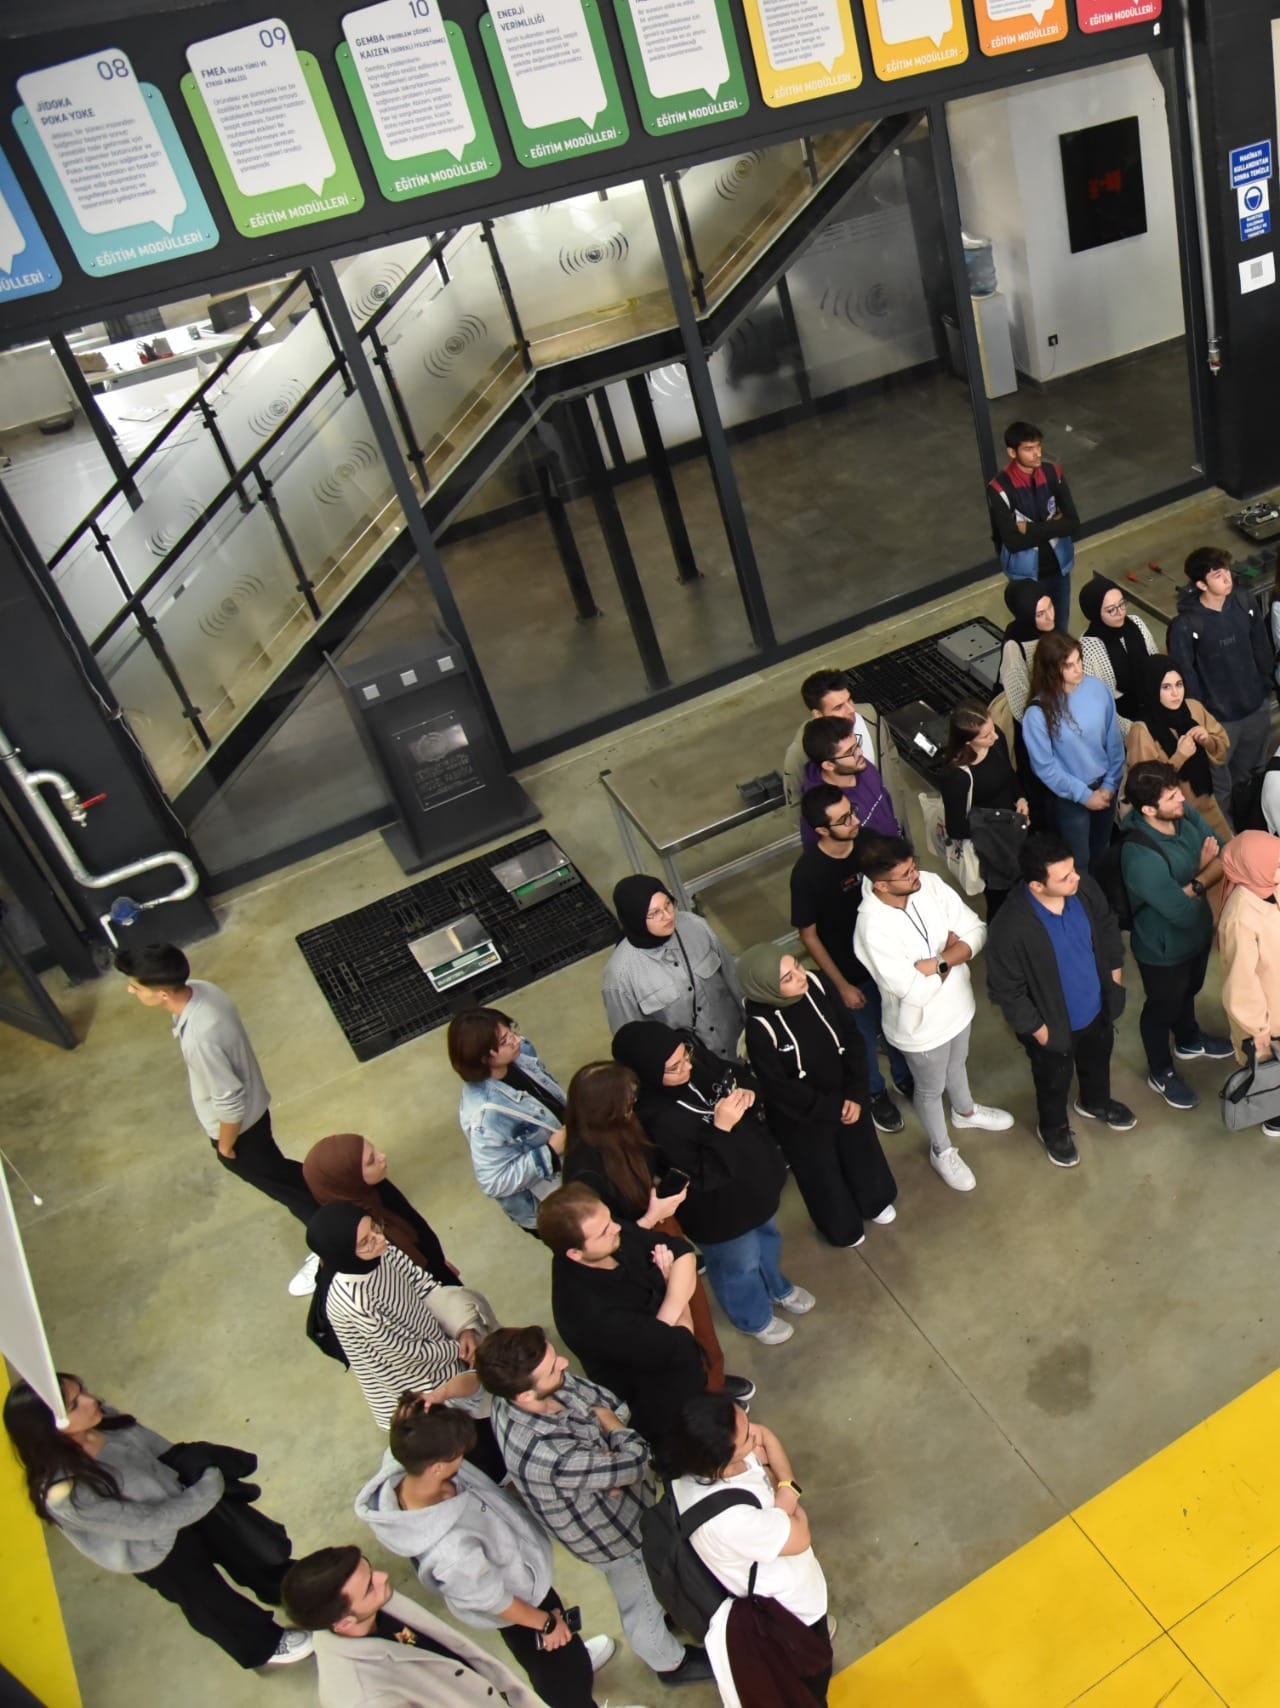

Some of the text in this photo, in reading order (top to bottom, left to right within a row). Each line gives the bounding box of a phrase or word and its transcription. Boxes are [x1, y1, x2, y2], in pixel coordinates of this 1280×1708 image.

[409, 0, 430, 18] 10
[497, 6, 524, 19] ENERJİ
[500, 14, 545, 31] VERİMLİLİĞİ
[258, 27, 287, 48] 09
[355, 34, 385, 47] GEMBA
[97, 58, 129, 81] 08
[201, 66, 227, 79] FMEA
[41, 108, 96, 126] POKA YOKE
[656, 97, 738, 128] EĞİTİM MODÜLLERİ
[530, 126, 617, 158] EĞİTİM MODÜLLERİ
[395, 157, 488, 192] EĞİTİM MODÜLLERİ
[249, 192, 349, 228] EĞİTİM MODÜLLERİ
[95, 229, 203, 267] EĞİTİM MODÜLLERİ
